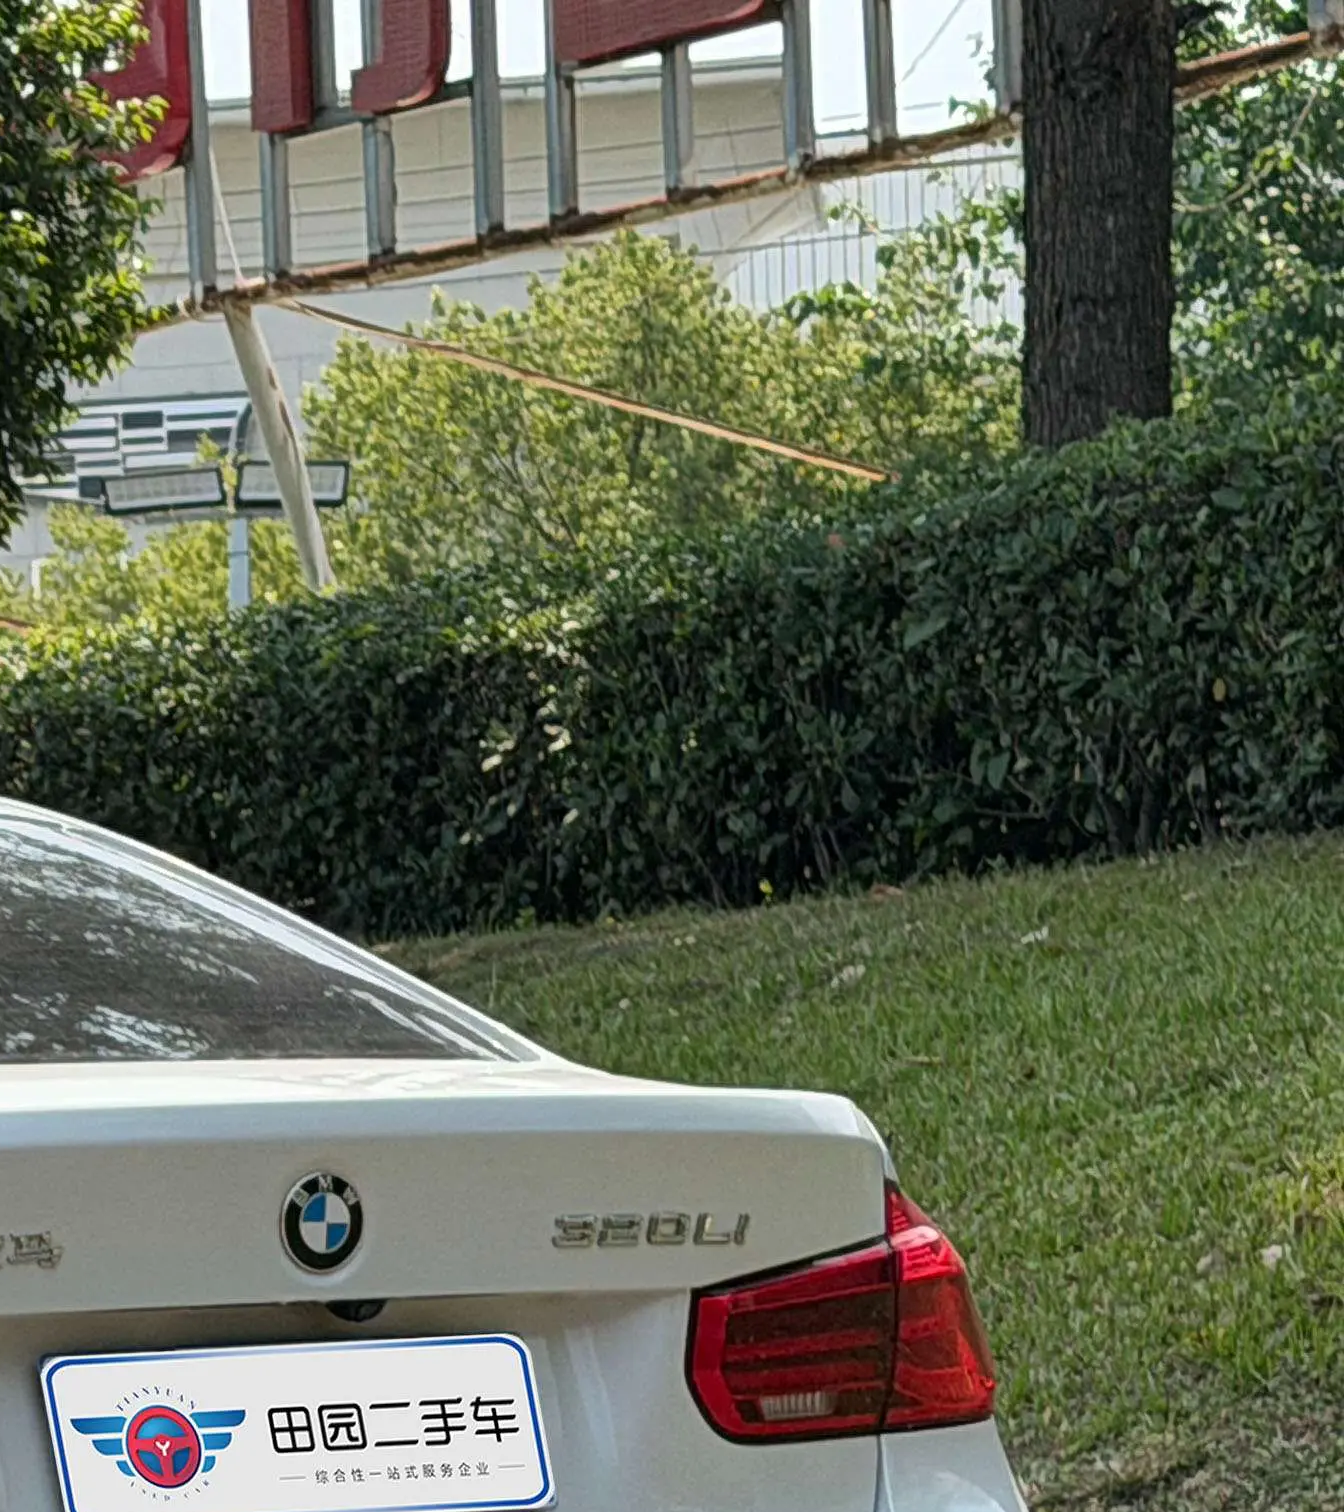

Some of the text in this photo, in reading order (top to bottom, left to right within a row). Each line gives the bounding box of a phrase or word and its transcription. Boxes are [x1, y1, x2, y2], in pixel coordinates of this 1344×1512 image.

[267, 1397, 520, 1454] 田园二手车
[314, 1462, 491, 1485] 综合性一站式服务企业
